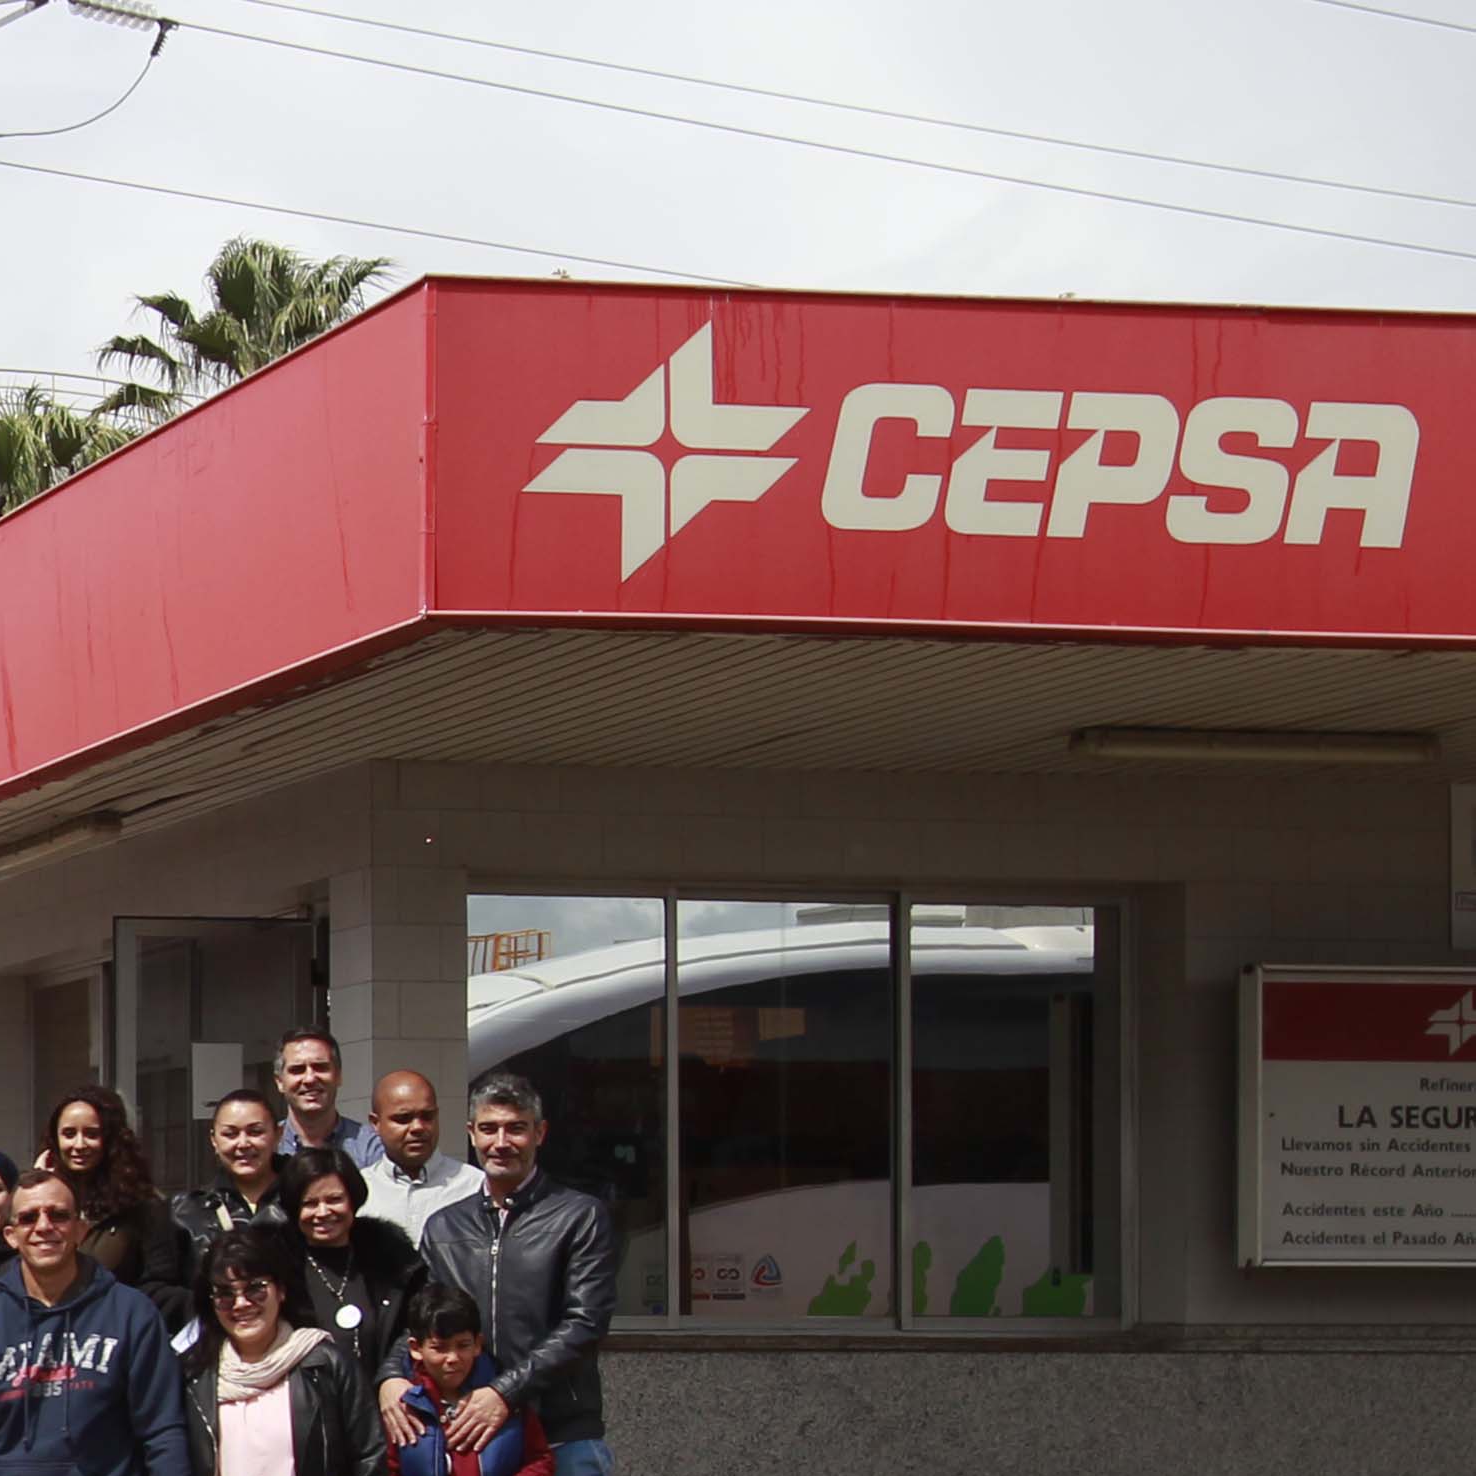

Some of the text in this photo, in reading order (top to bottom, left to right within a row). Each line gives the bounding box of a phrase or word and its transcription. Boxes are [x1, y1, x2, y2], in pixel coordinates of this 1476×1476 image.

[820, 381, 1421, 549] CEPSA
[1419, 1077, 1476, 1092] Refiner
[1338, 1105, 1378, 1129] LA
[1281, 1137, 1471, 1152] Llevamos sin Accidentes
[1280, 1162, 1344, 1177] Nuestro
[1282, 1202, 1444, 1217] Accidentes este Año
[1282, 1230, 1476, 1246] Accidentes el Pasado Añ
